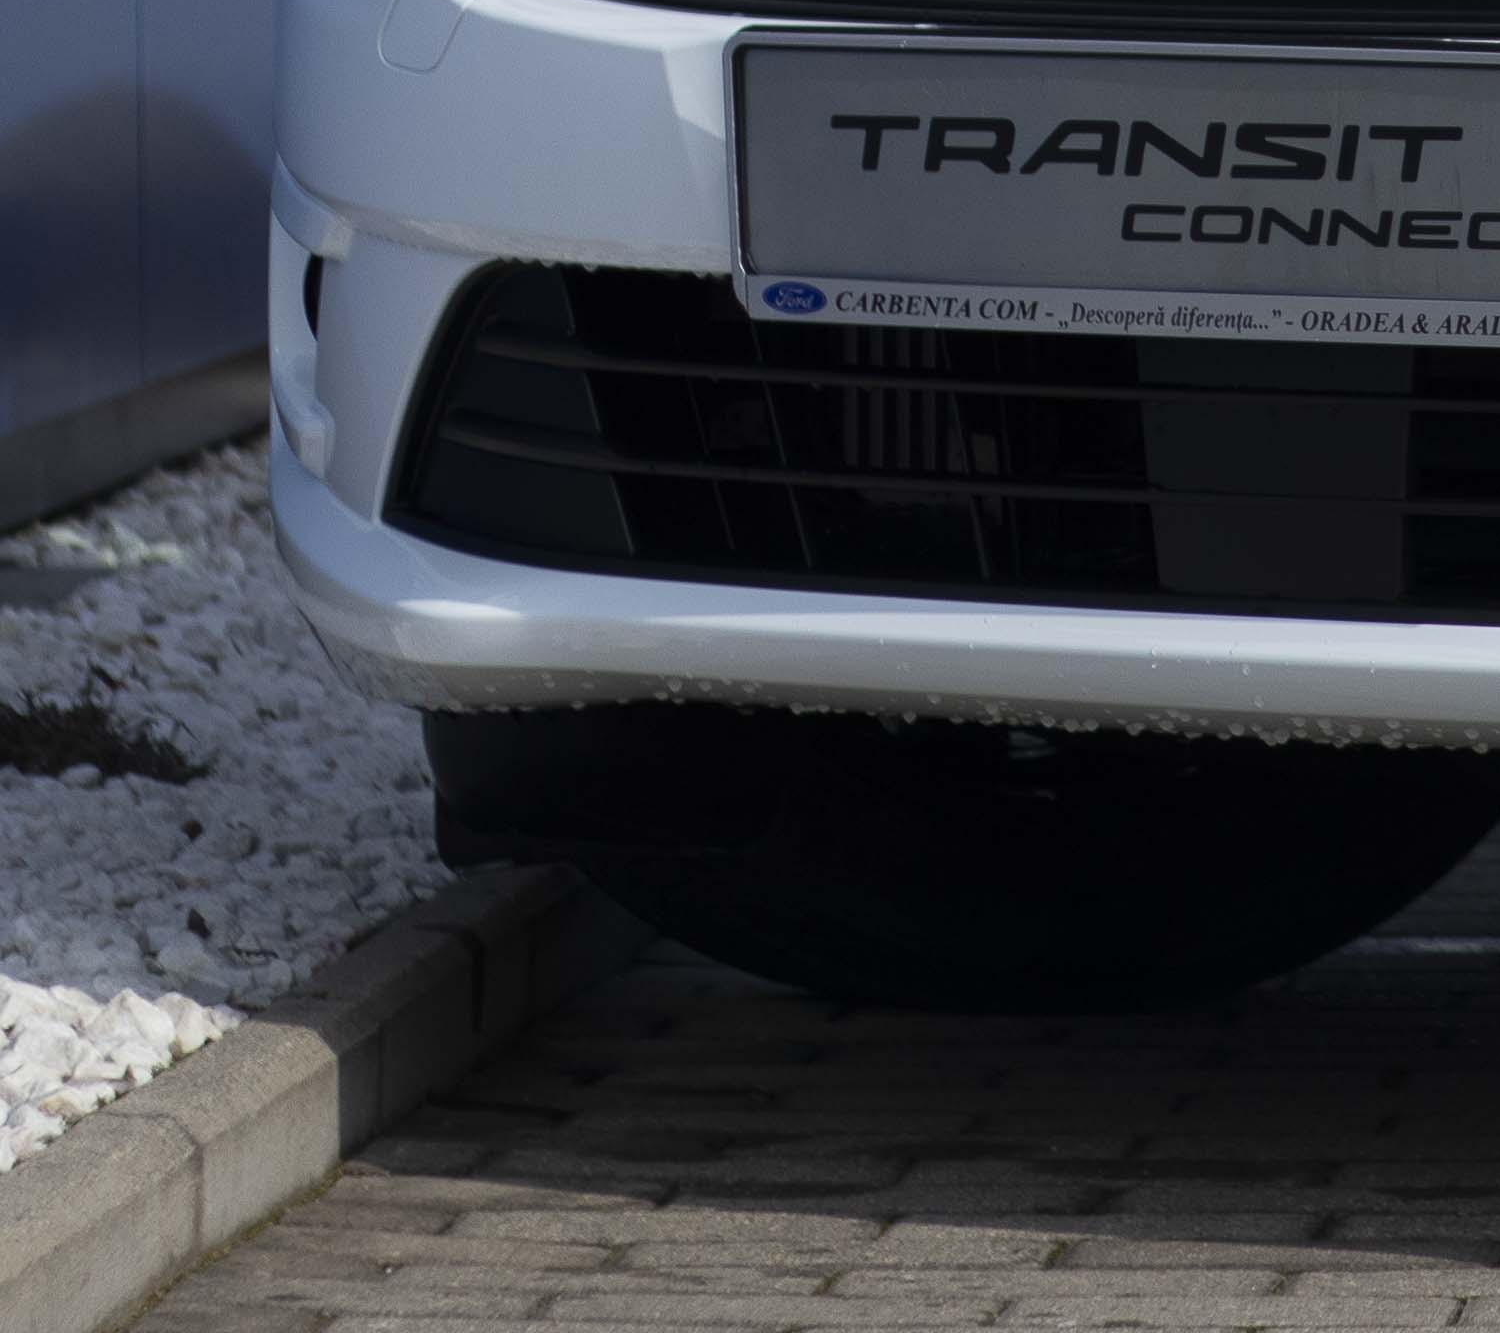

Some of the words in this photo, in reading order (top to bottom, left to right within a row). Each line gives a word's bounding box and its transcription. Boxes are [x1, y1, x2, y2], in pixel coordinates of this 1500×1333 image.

[831, 114, 1463, 183] TRANSIT
[835, 290, 973, 319] CARBENTA
[979, 298, 1039, 322] COM
[1301, 310, 1405, 334] ORADEA
[1411, 312, 1429, 334] &
